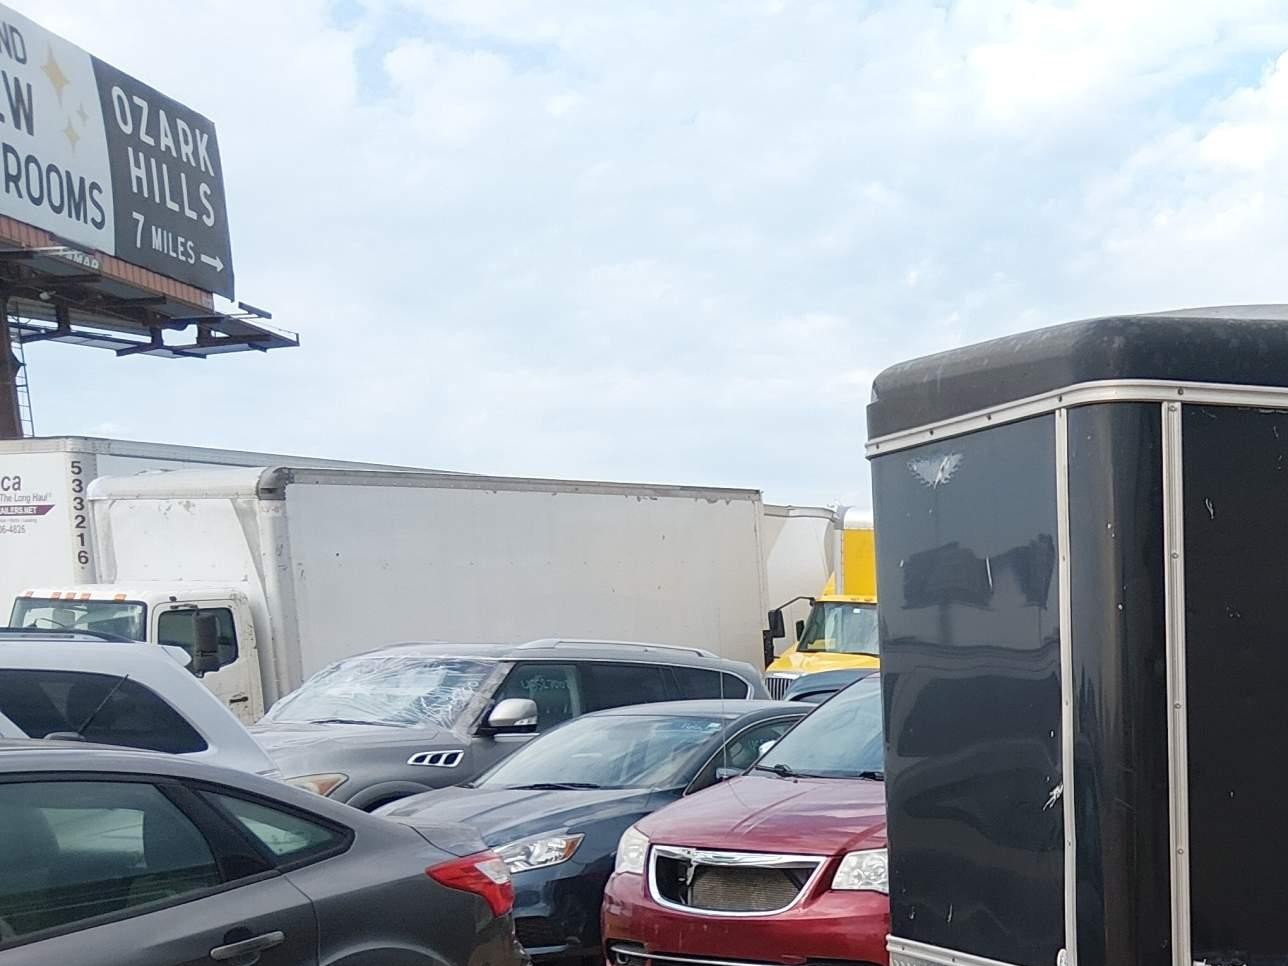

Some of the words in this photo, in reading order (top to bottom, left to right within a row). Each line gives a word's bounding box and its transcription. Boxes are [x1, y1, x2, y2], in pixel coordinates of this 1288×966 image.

[0, 70, 34, 136] W
[112, 86, 215, 176] OZARK
[2, 142, 106, 230] ROOMS
[128, 147, 215, 227] HILLS
[132, 212, 145, 248] 7
[152, 225, 195, 264] MILES
